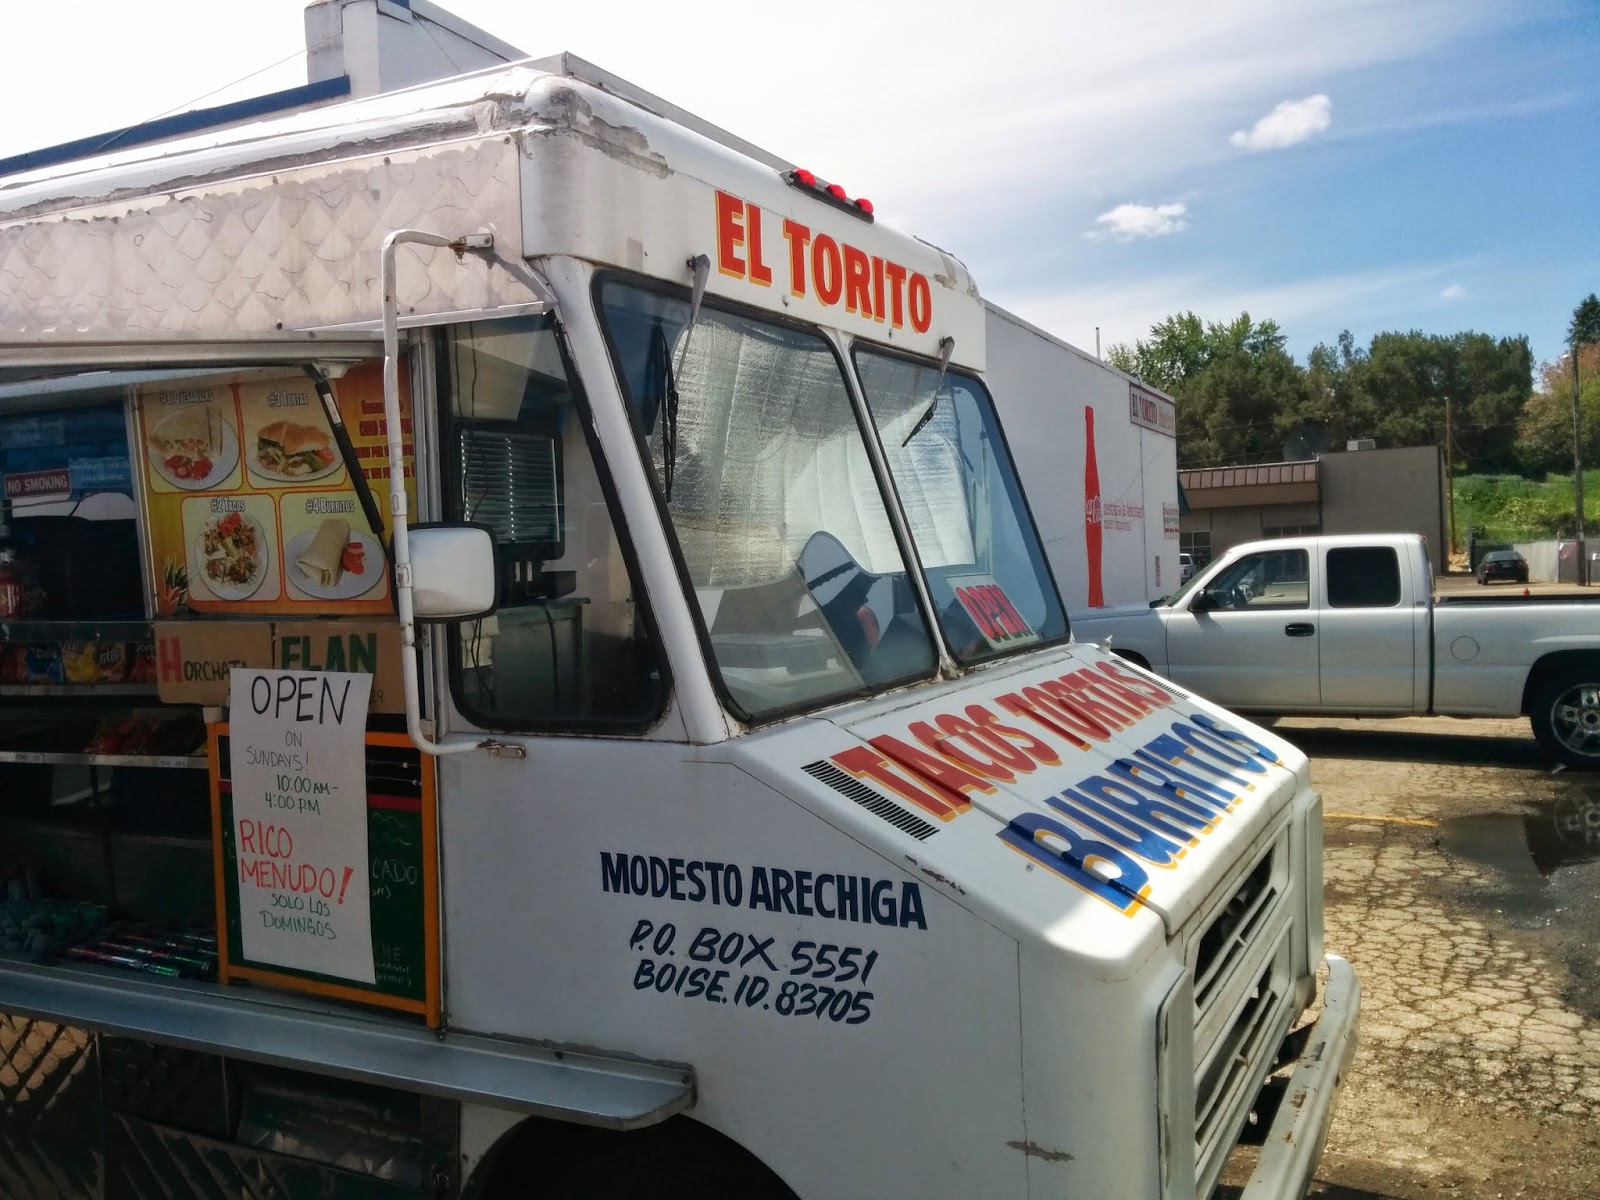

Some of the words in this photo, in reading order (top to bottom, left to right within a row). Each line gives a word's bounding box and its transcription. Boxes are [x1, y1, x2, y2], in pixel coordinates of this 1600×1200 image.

[714, 189, 772, 288] EL
[783, 217, 932, 334] TORITO
[267, 392, 281, 407] #3
[7, 480, 21, 494] NO
[24, 475, 68, 492] SMOKING
[210, 498, 223, 513] #2
[305, 498, 319, 514] #4
[955, 584, 1034, 644] OPEN
[281, 632, 378, 674] FLAN
[251, 675, 351, 725] OPEN
[246, 746, 309, 772] SUNDAYS!
[285, 731, 302, 747] ON
[830, 704, 1062, 824] TACOS
[994, 660, 1177, 752] TORTAS
[265, 792, 295, 810] 4:00
[996, 713, 1284, 919] BURRITOS
[240, 819, 293, 859] RICO
[271, 893, 304, 911] SOLO
[309, 898, 331, 917] LOS
[599, 851, 743, 907] MODESTO
[749, 865, 928, 931] ARECHIGA
[260, 910, 336, 940] DOMINGOS
[629, 919, 677, 957] P.O.
[687, 927, 780, 972] BOX
[790, 941, 879, 986] 5551
[774, 980, 875, 1025] 83705
